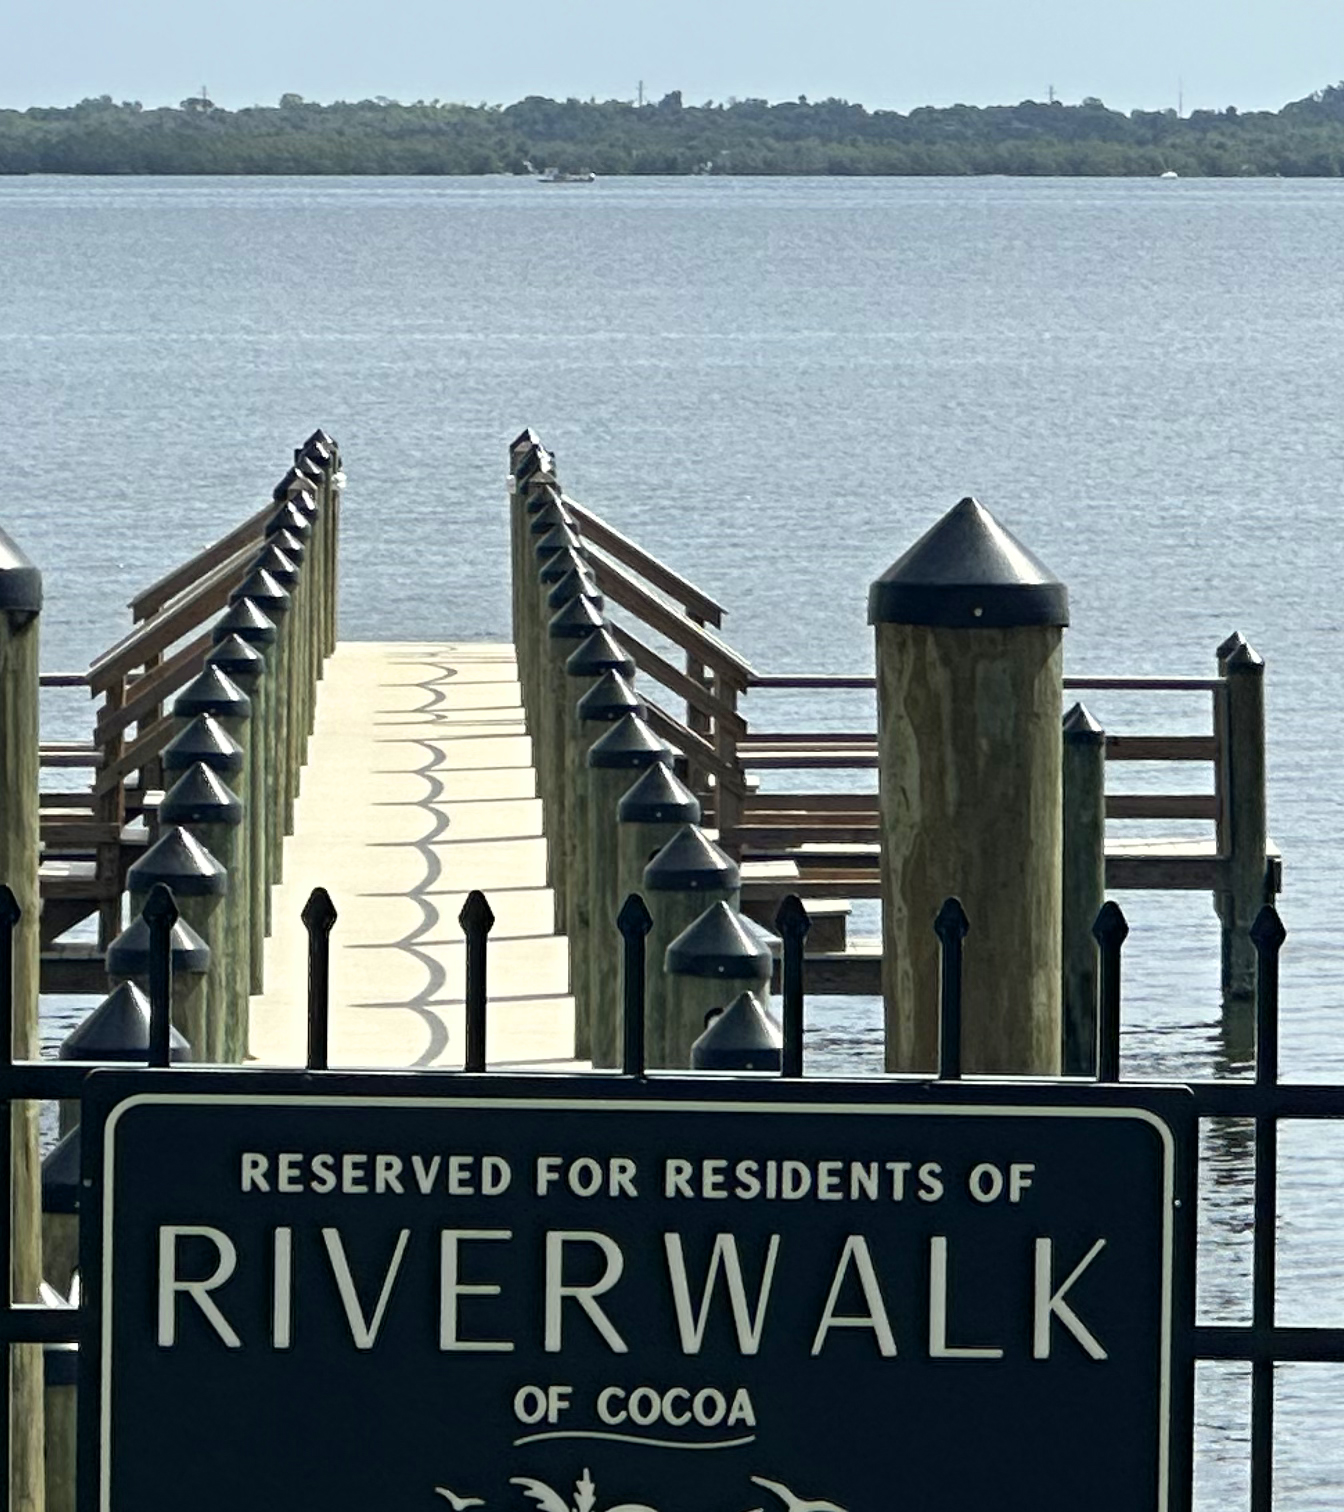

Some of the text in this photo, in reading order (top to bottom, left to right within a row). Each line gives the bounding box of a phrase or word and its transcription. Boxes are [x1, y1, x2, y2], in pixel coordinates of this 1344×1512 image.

[241, 1152, 1036, 1204] RESERVED FOR RESIDENTS OF
[157, 1224, 1109, 1361] RIVERWALK
[513, 1384, 757, 1427] OF COCOA
